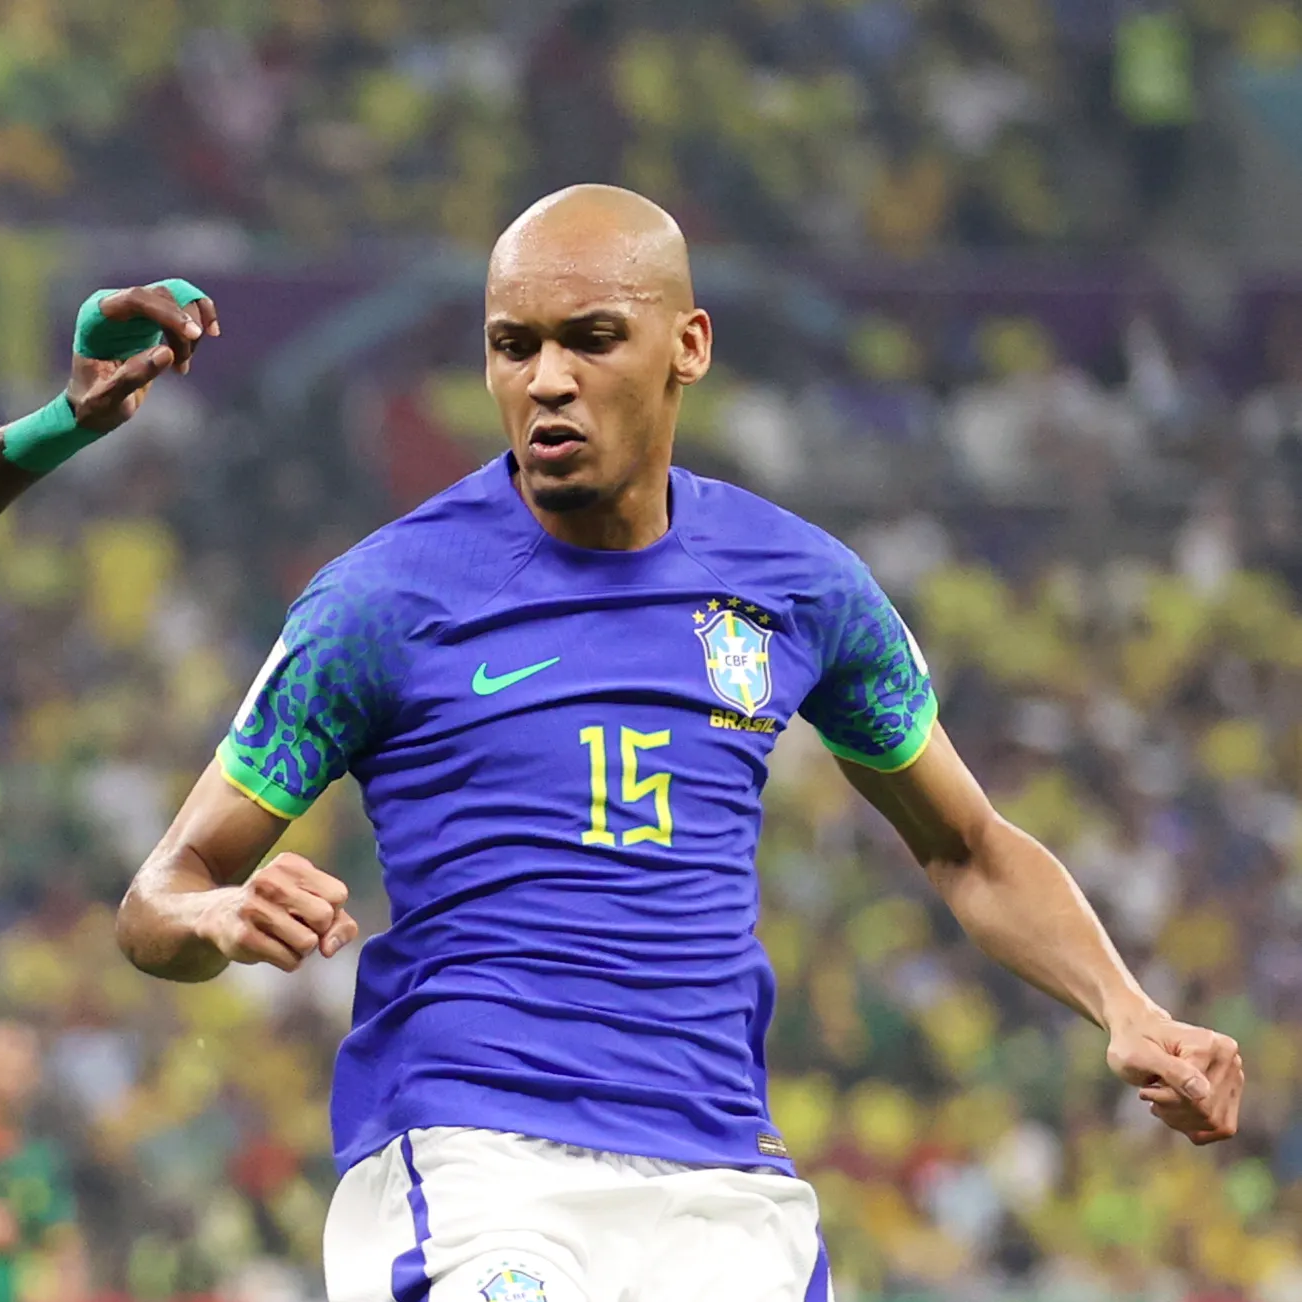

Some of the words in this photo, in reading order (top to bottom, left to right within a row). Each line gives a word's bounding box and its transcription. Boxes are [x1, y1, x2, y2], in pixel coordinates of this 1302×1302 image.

[724, 654, 749, 667] CBF
[709, 708, 777, 734] BRASIL
[579, 724, 673, 848] 15
